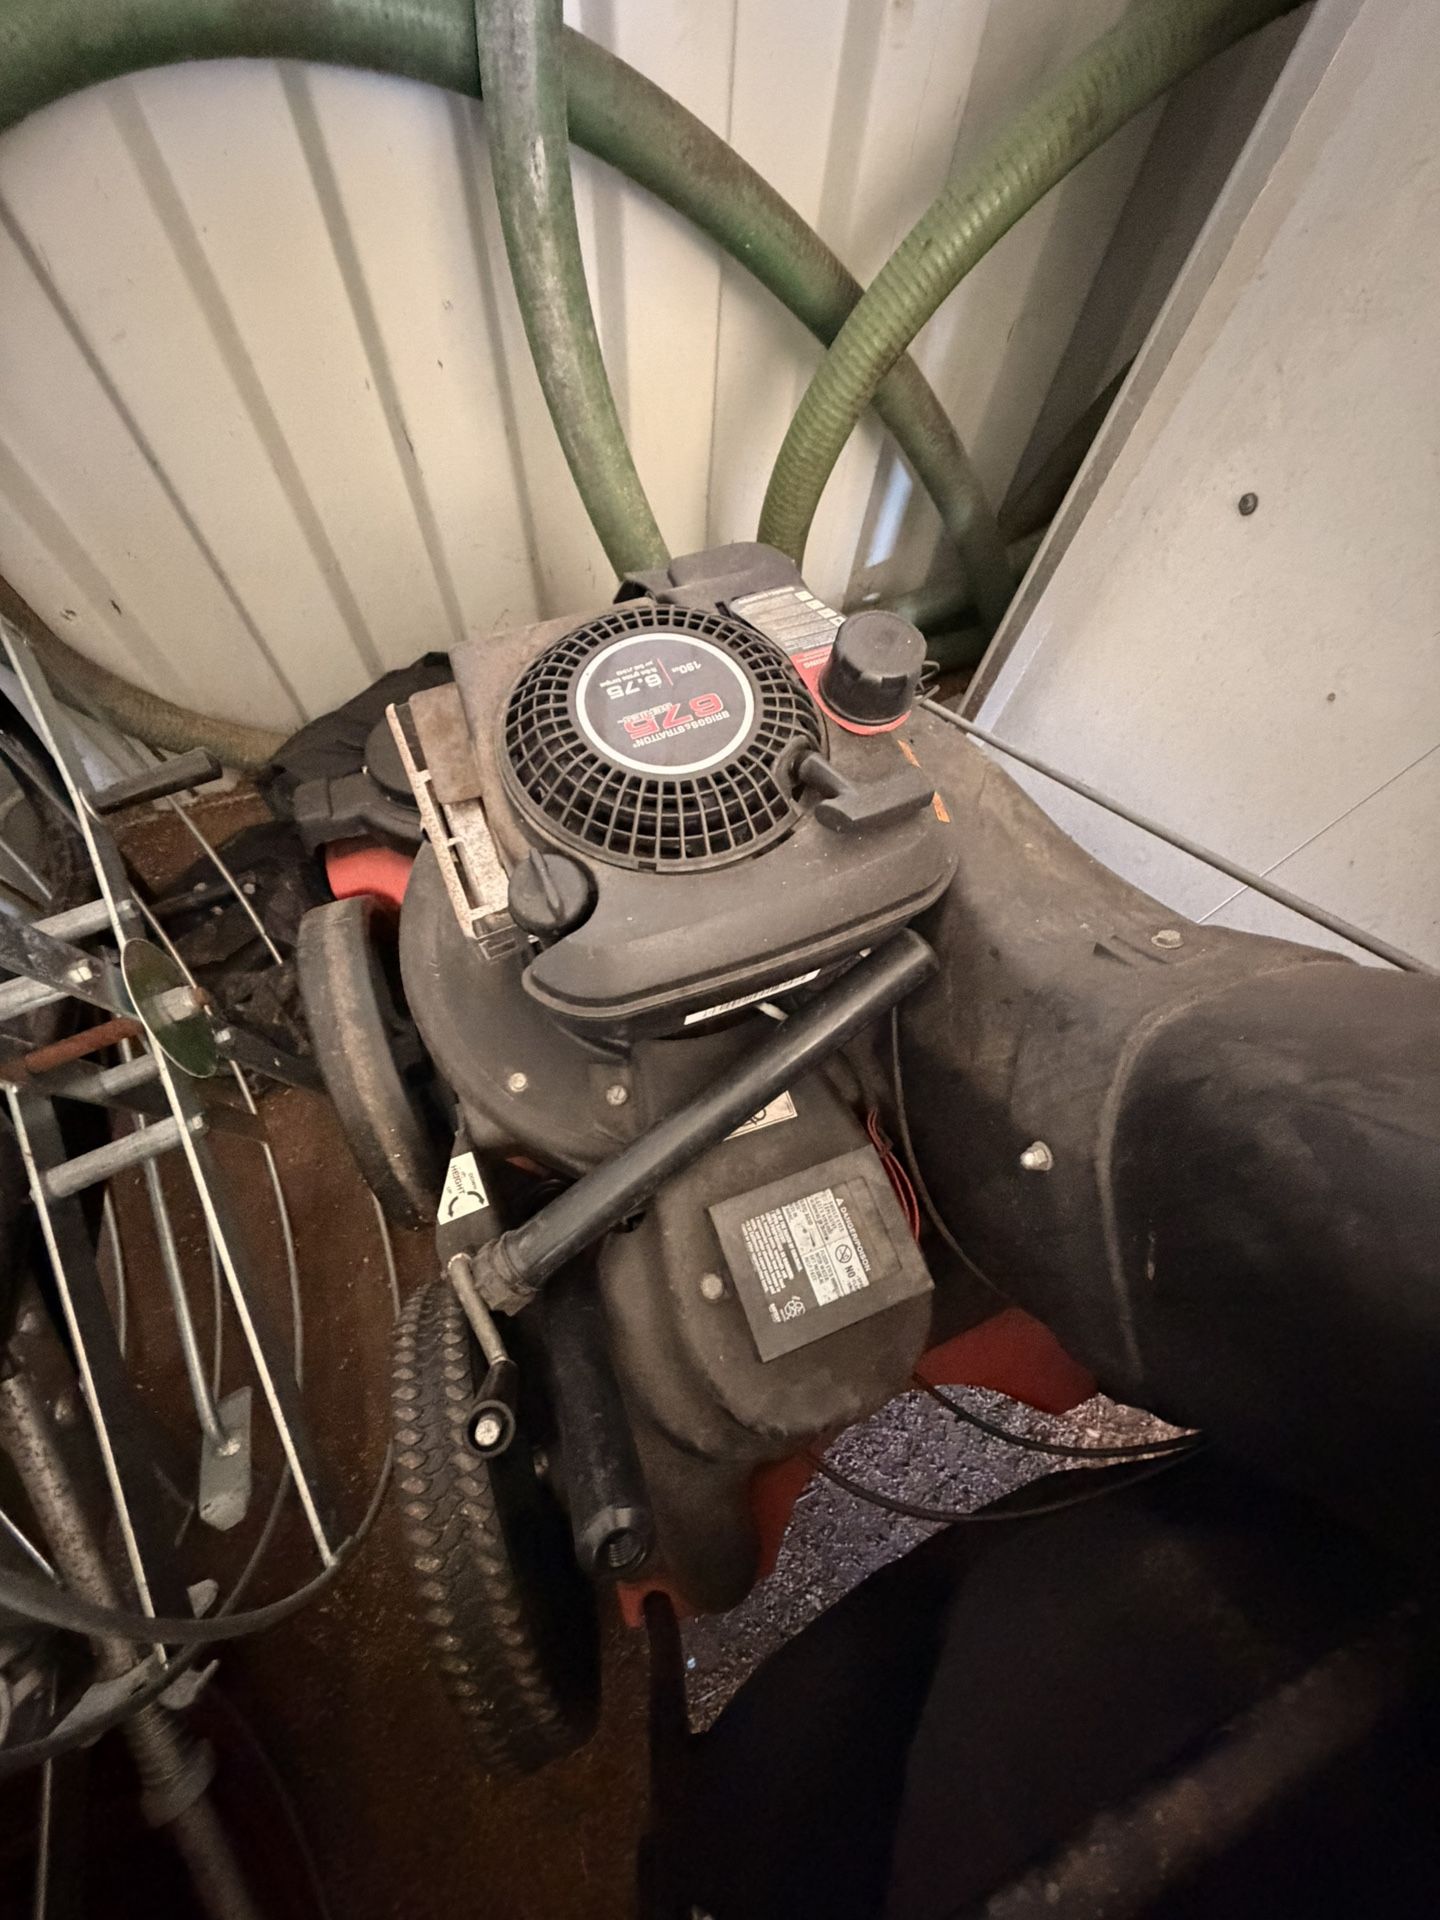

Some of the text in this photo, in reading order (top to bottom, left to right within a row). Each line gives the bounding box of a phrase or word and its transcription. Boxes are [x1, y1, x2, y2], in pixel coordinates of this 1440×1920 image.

[606, 674, 662, 700] 6.75
[623, 693, 724, 739] 675
[450, 1164, 465, 1194] HEIGHT
[841, 1207, 872, 1272] DANGER/POISON
[844, 1264, 856, 1278] NO
